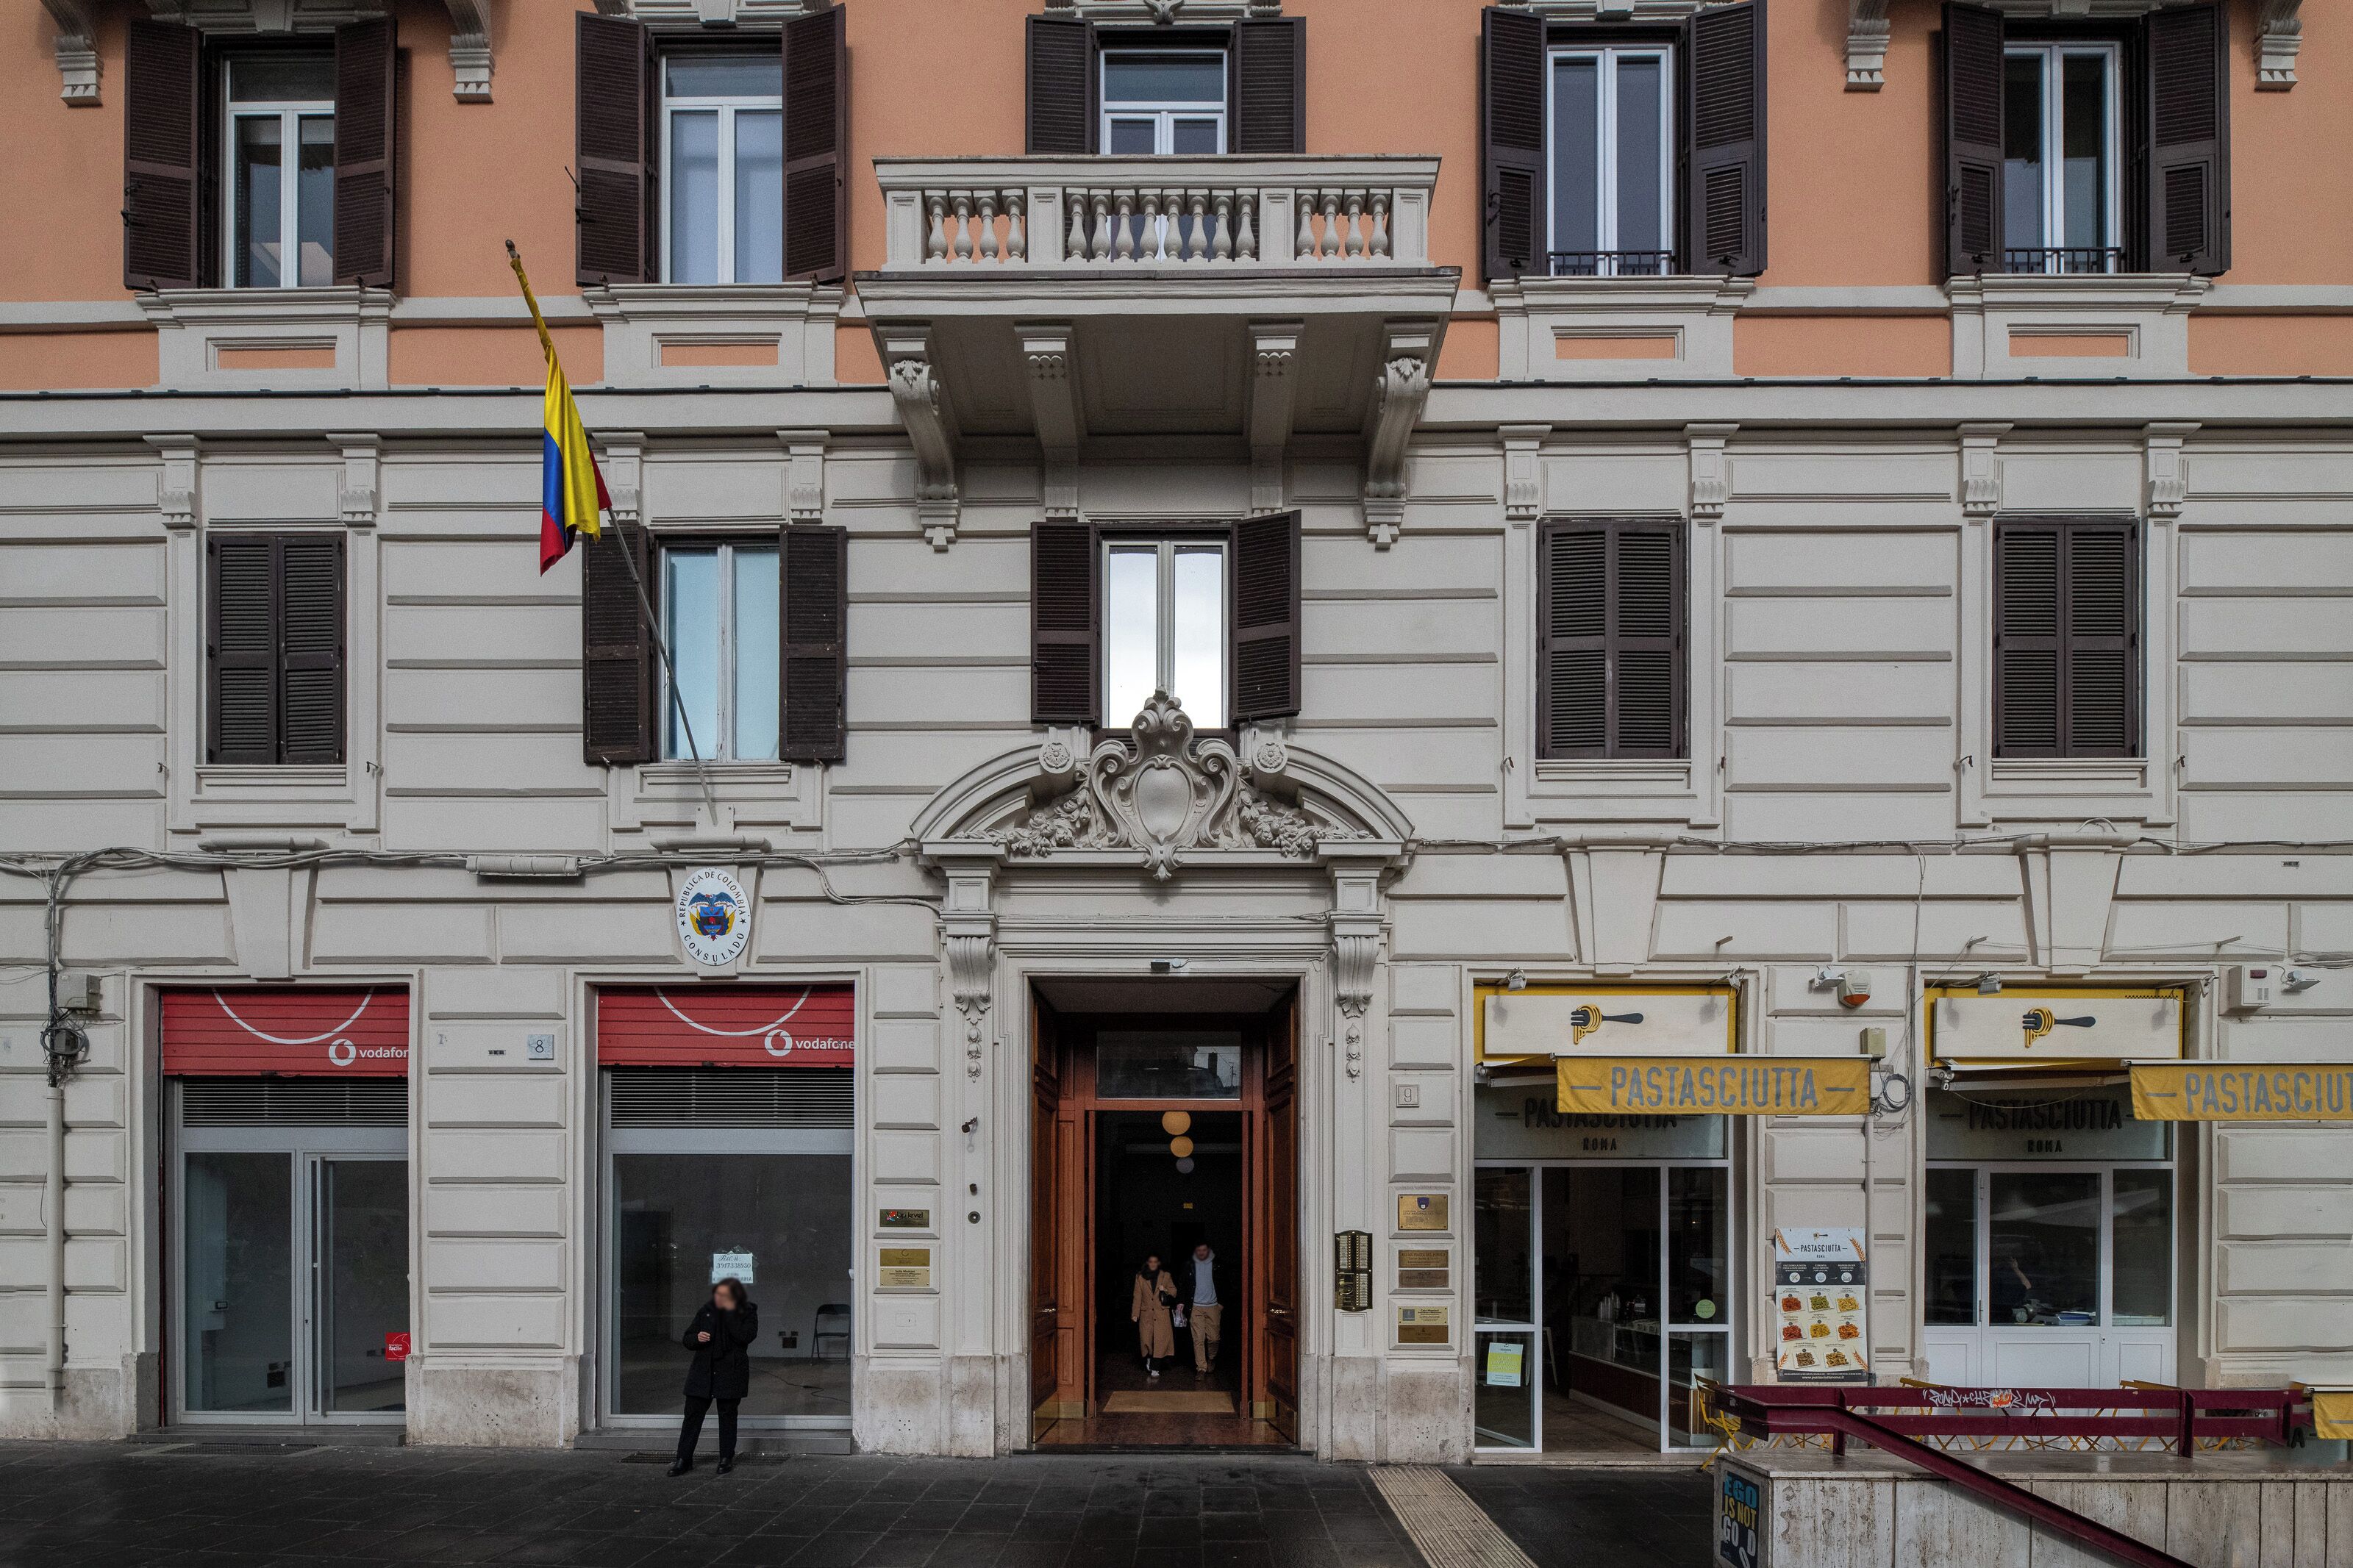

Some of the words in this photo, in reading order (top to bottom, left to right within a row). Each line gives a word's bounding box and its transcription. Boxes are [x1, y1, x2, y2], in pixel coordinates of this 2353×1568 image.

[679, 874, 704, 918] REPUBLICA
[717, 873, 746, 916] COLOMBIA
[684, 932, 745, 962] CONSULADO
[535, 1039, 544, 1053] 8
[796, 1037, 854, 1050] vodafone
[1404, 1087, 1412, 1103] 9
[1610, 1066, 1818, 1107] PASTASCIUTTA
[1969, 1099, 2123, 1130] PASTASCIUTTA
[1582, 1137, 1618, 1151] ROMA
[2027, 1139, 2063, 1153] ROMA
[1800, 1245, 1841, 1253] PASTASCIUTTA
[1724, 1475, 1757, 1508] EGO
[1724, 1494, 1735, 1519] IS
[1737, 1502, 1757, 1530] NOT
